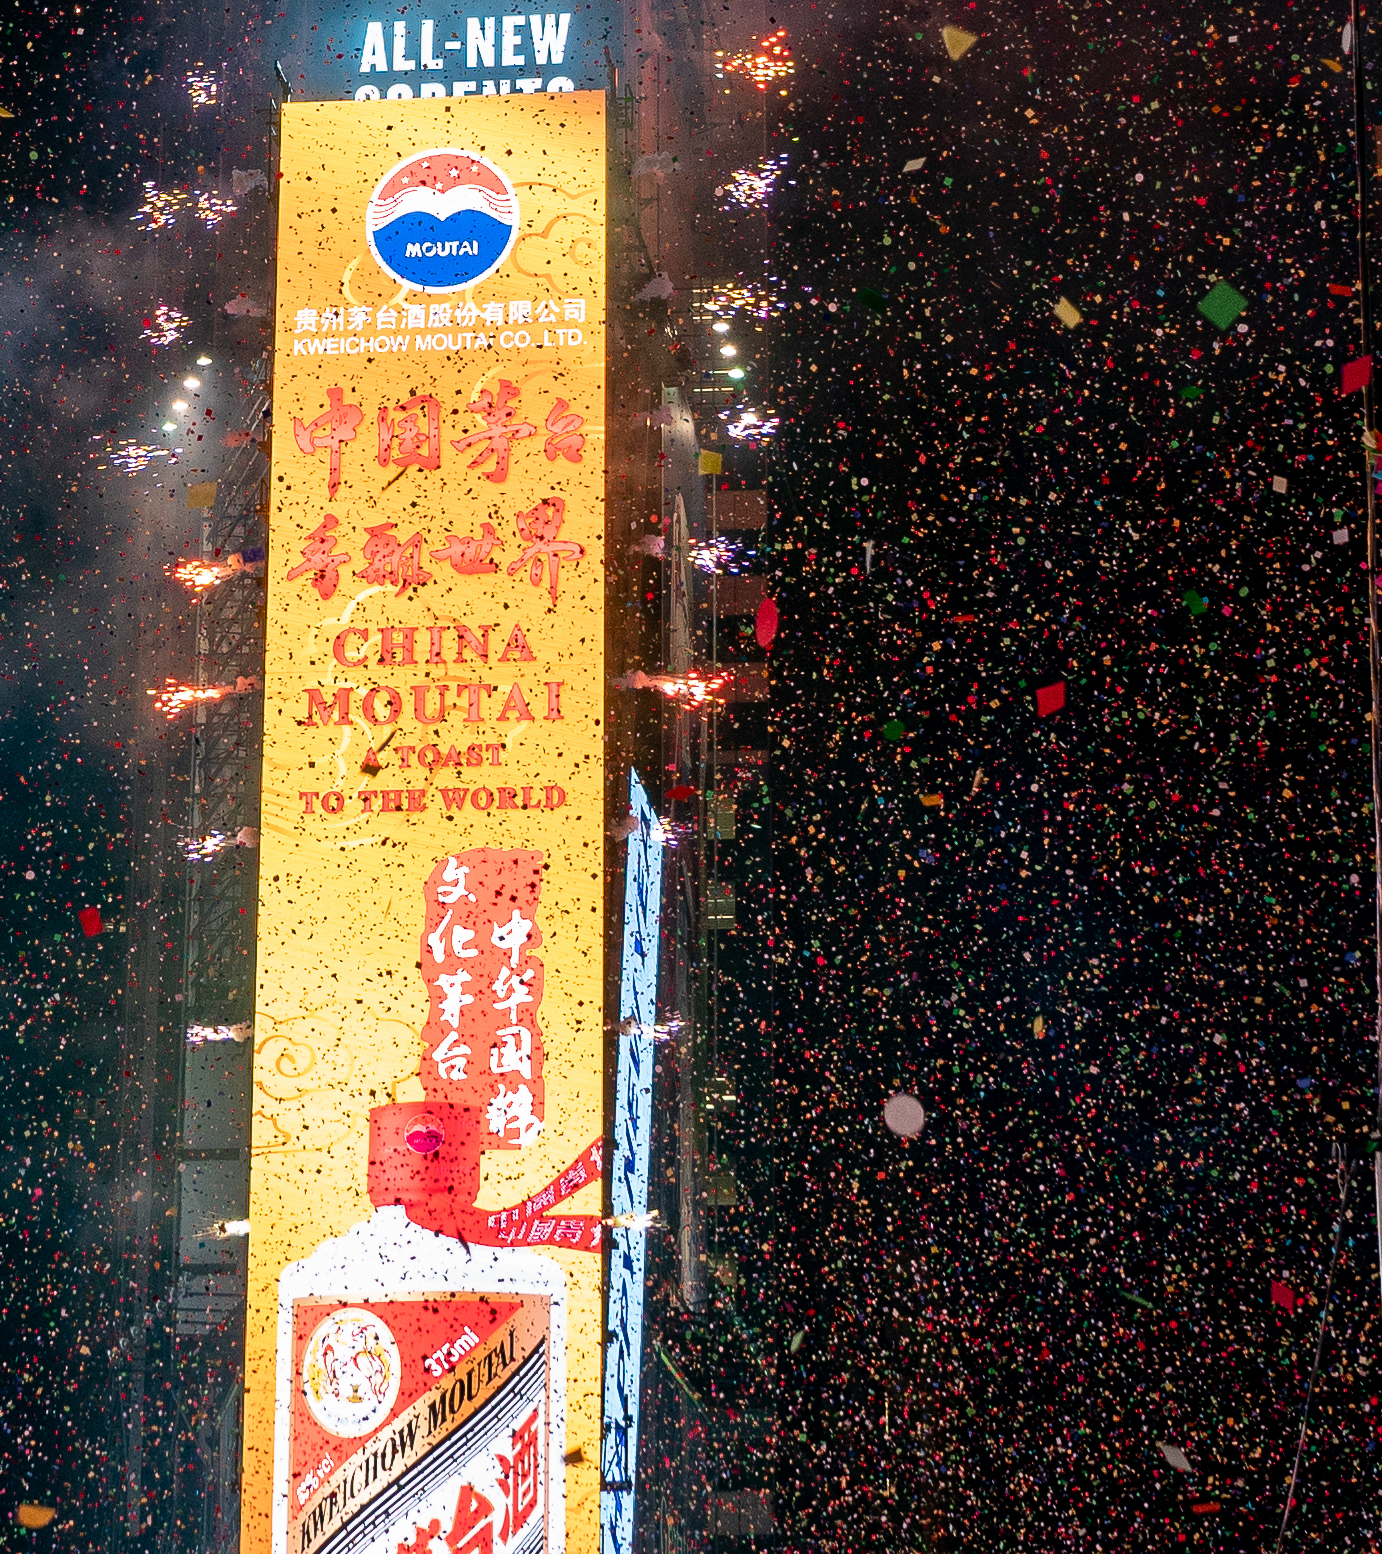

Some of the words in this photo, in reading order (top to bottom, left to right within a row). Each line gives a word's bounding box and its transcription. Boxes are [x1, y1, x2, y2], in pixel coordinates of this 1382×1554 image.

[359, 12, 572, 73] ALL-NEW
[405, 240, 479, 257] MOUTAI
[294, 299, 586, 334] 贵州茅台酒股份有限公司
[293, 335, 410, 356] KWEICHOW
[415, 332, 495, 352] MOUTAI
[293, 379, 585, 498] 中国茅台
[333, 624, 537, 667] CHINA
[303, 680, 565, 727] MOUTAI
[394, 743, 507, 770] TOAST
[299, 790, 345, 815] TO
[358, 788, 427, 813] THE
[439, 785, 566, 812] WORLD
[423, 856, 479, 1081] 文化茅台
[424, 1326, 480, 1377] 375ml
[300, 1413, 421, 1554] KWEICHOW
[426, 1328, 516, 1437] MOUTAI
